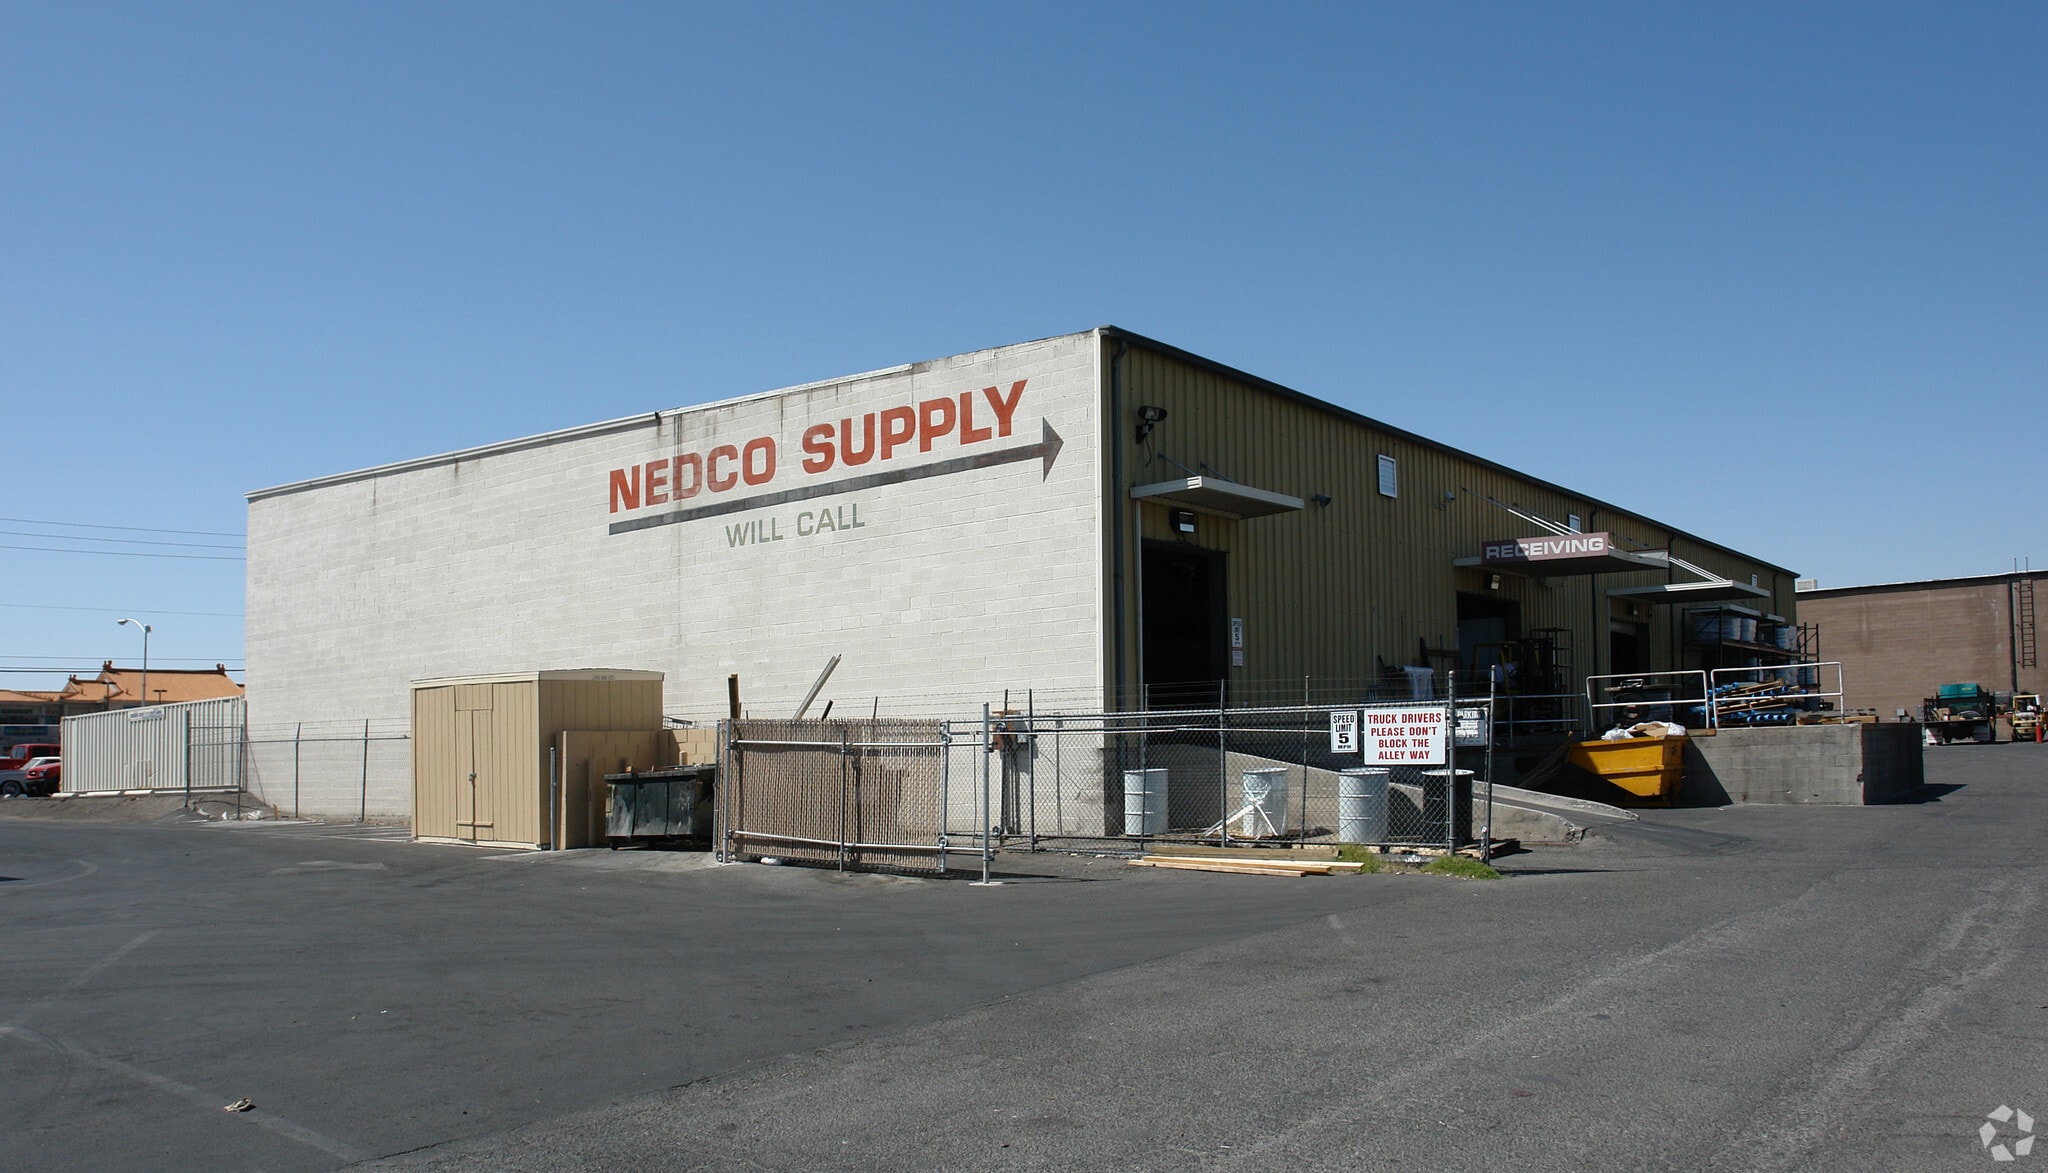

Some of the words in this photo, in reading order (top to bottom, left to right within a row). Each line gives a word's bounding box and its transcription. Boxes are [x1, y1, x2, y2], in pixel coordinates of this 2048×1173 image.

[609, 436, 777, 513] NEDCO
[801, 379, 1028, 475] SUPPLY
[725, 517, 784, 548] WILL
[797, 503, 866, 537] CALL
[1485, 537, 1604, 560] RECEIVING
[1333, 714, 1355, 724] SPEED
[1367, 714, 1397, 724] TRUCK
[1401, 712, 1442, 723] DRIVERS
[1335, 723, 1352, 733] LIMIT
[1370, 728, 1405, 737] PLEASE
[1409, 726, 1438, 736] DON'T
[1338, 732, 1350, 744] 5
[1378, 739, 1408, 748] BLOCK
[1411, 738, 1430, 748] THE
[1378, 751, 1405, 760] ALLEY
[1409, 750, 1430, 760] WAY
